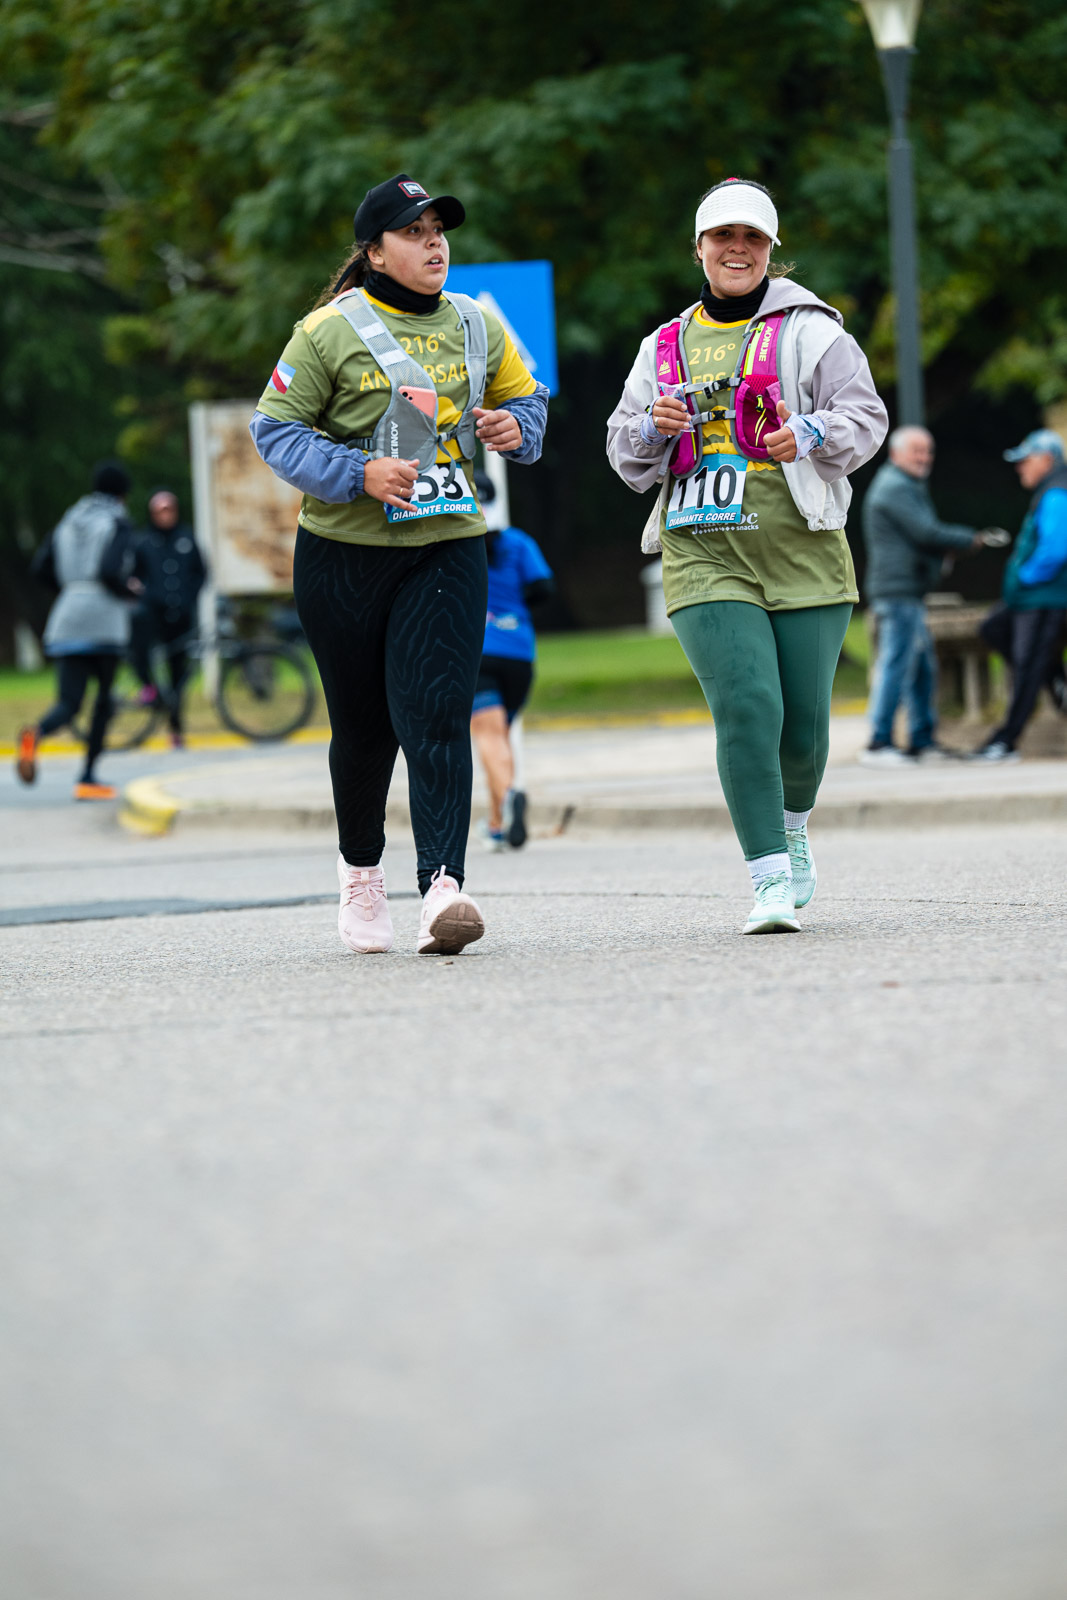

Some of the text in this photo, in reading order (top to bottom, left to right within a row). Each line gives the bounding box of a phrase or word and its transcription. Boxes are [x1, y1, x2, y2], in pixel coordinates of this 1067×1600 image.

[758, 325, 773, 362] AONIJIE
[401, 462, 464, 503] 53
[677, 464, 737, 513] 110
[392, 503, 473, 521] DIAMANTE CORRE
[668, 512, 705, 528] DIAMANTE
[705, 512, 737, 522] CORRE
[735, 524, 760, 532] snacks
